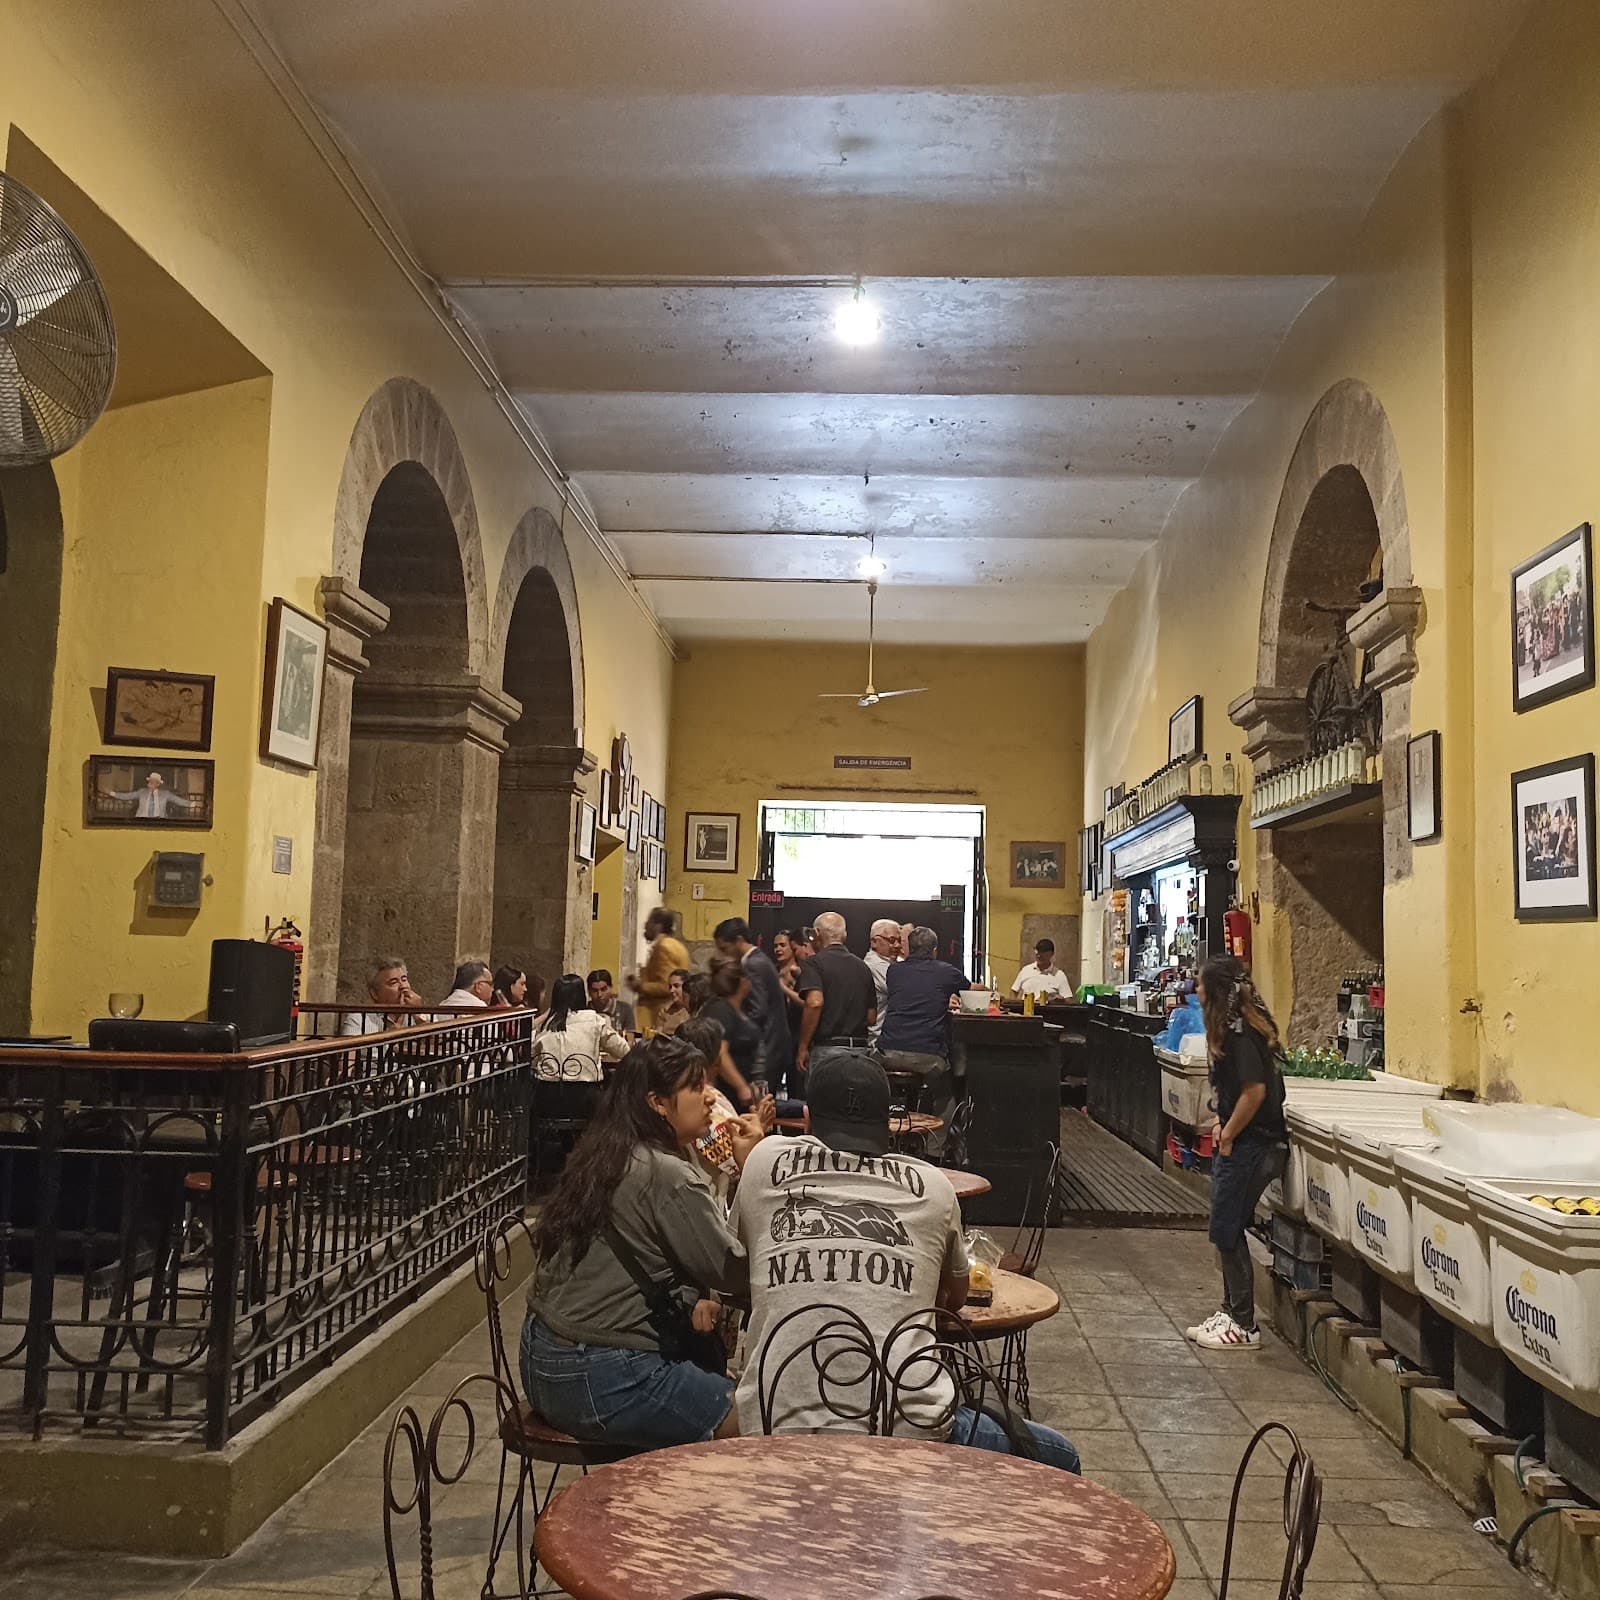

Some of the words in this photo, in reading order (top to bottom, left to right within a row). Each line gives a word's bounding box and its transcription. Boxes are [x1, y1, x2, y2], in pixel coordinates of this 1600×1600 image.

[752, 891, 781, 902] Entrada
[770, 1145, 925, 1198] CHICANO
[1307, 1176, 1331, 1208] Corona
[1356, 1200, 1388, 1238] Corona
[1364, 1229, 1384, 1256] Extra
[1421, 1236, 1460, 1281] Corona
[767, 1249, 915, 1294] NATION
[1430, 1269, 1456, 1301] Extra
[1505, 1285, 1558, 1341] Corona
[1519, 1325, 1552, 1363] Extra
